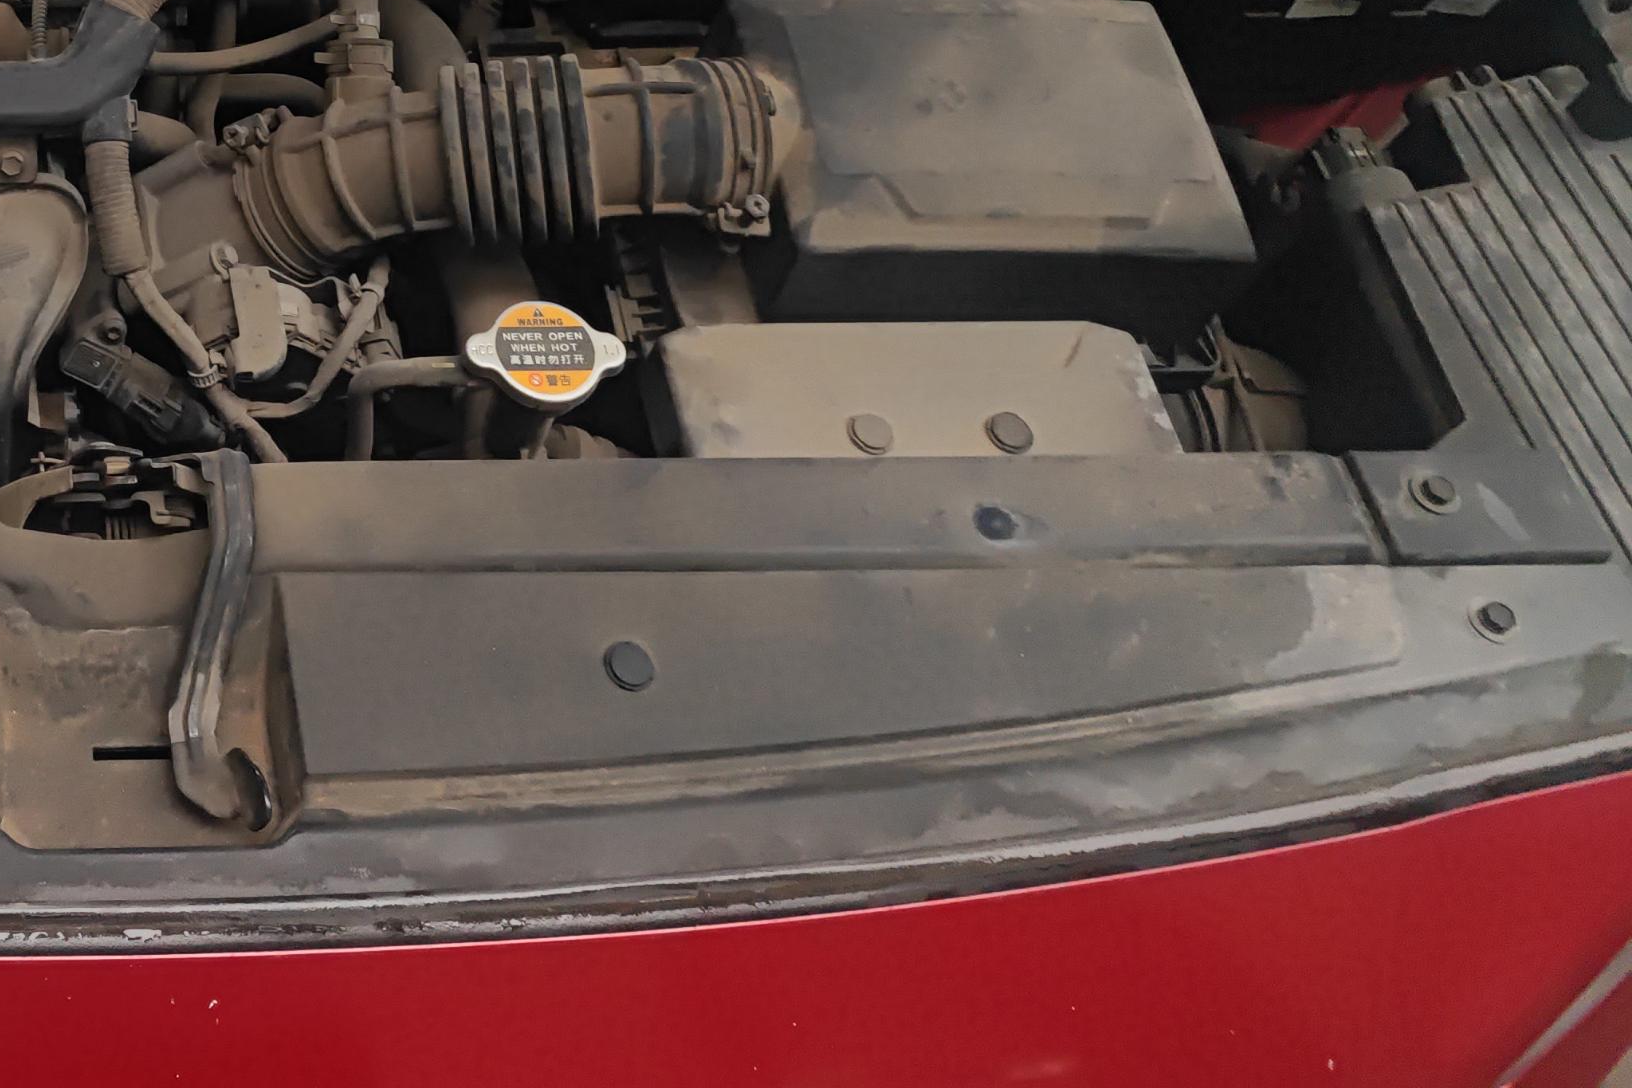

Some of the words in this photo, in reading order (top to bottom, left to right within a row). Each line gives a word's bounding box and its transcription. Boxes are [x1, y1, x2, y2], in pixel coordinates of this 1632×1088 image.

[517, 318, 564, 326] WARNING
[502, 332, 543, 342] NEVER
[548, 331, 584, 341] OPEN
[510, 343, 546, 352] WHEN
[551, 343, 578, 352] HOT
[509, 355, 585, 365] 高温时勿打开
